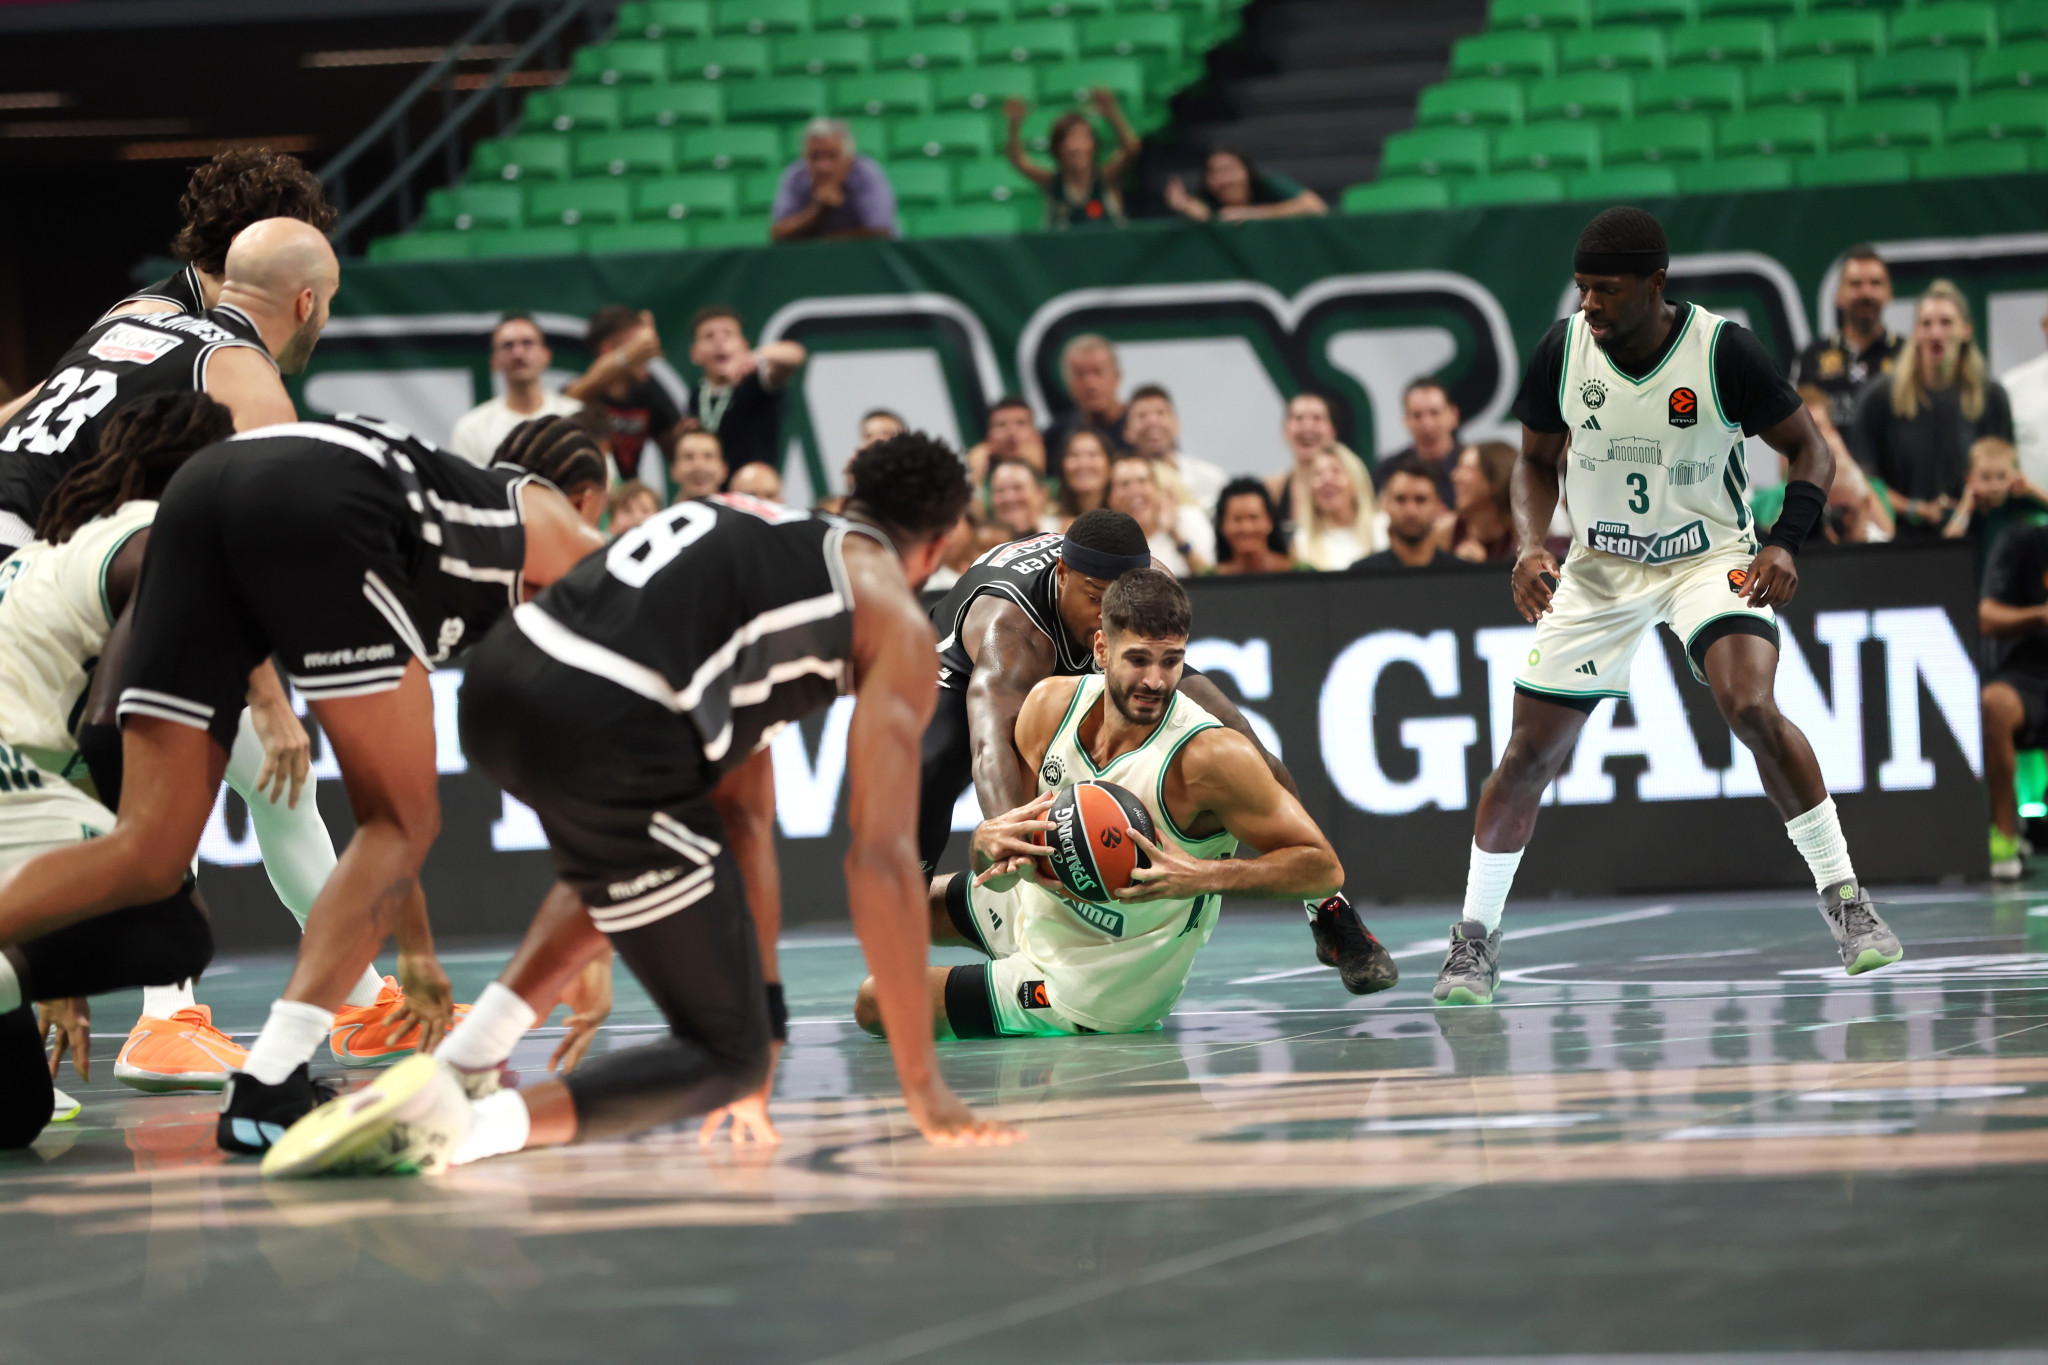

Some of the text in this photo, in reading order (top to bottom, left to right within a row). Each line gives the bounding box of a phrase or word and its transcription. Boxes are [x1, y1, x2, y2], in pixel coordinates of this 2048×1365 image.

[0, 366, 118, 456] 33
[1598, 522, 1627, 535] pame
[1626, 472, 1650, 515] 3
[605, 500, 718, 589] 8
[1054, 803, 1098, 892] SPALDING
